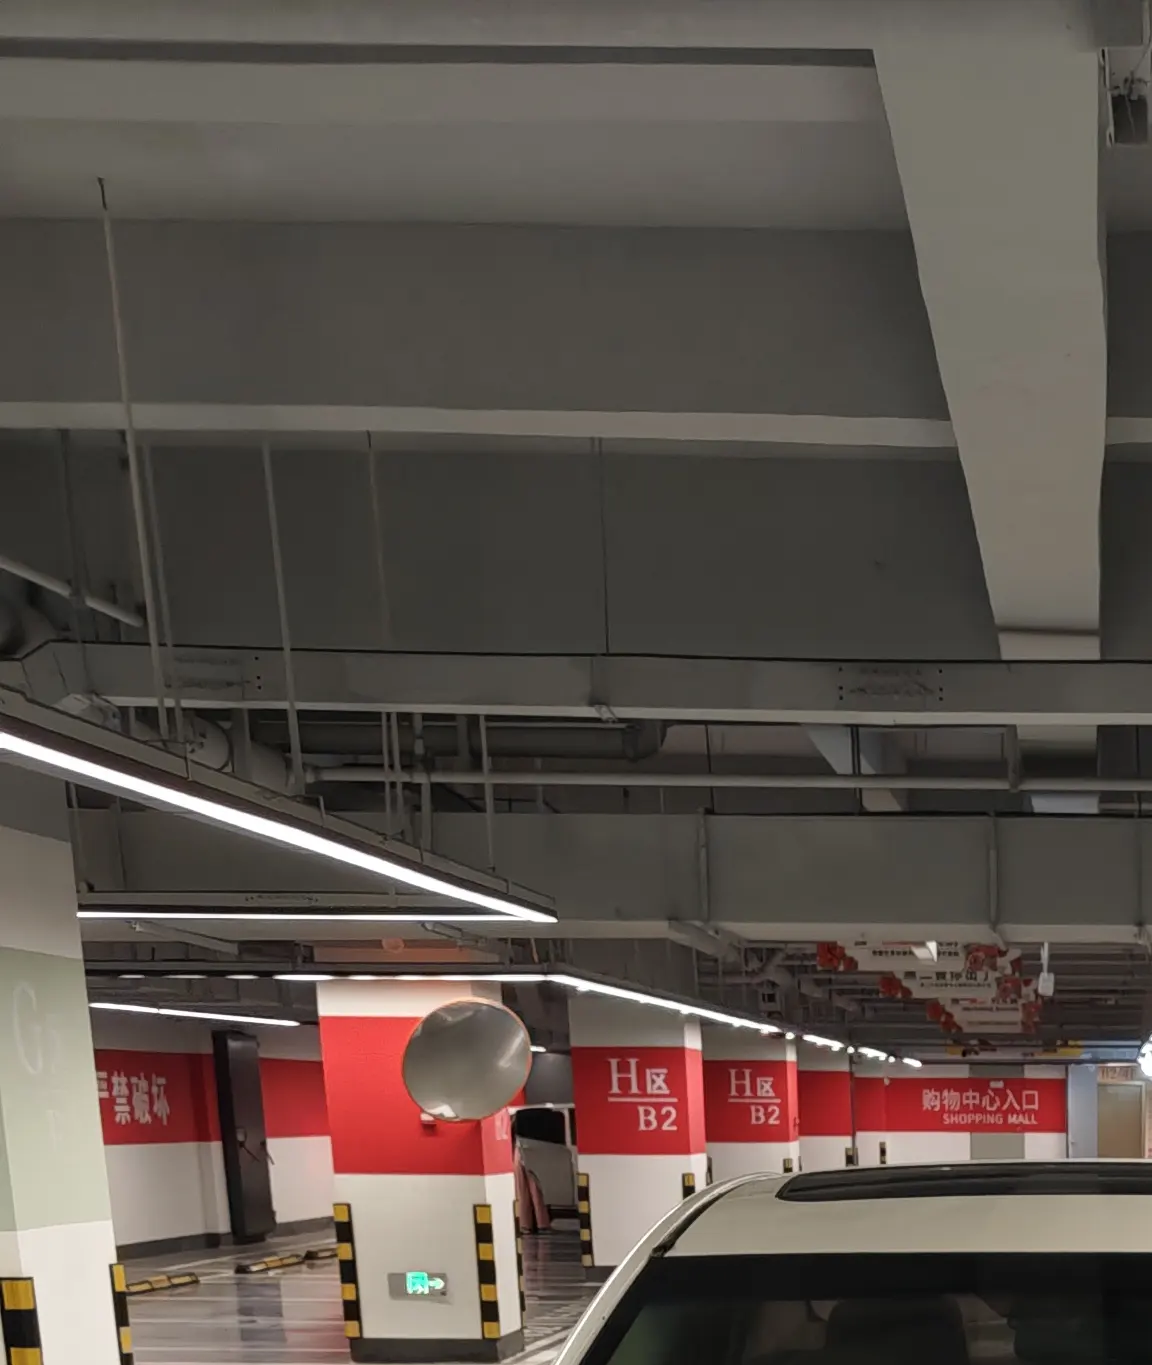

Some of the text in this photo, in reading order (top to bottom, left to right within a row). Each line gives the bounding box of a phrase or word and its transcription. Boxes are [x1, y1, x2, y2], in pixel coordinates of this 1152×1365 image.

[607, 1057, 670, 1095] H区
[728, 1068, 775, 1097] H区
[922, 1088, 1039, 1112] 购物中心入口
[637, 1105, 678, 1132] B2
[750, 1105, 780, 1125] B2
[943, 1113, 1039, 1125] SHOPPING MALL
